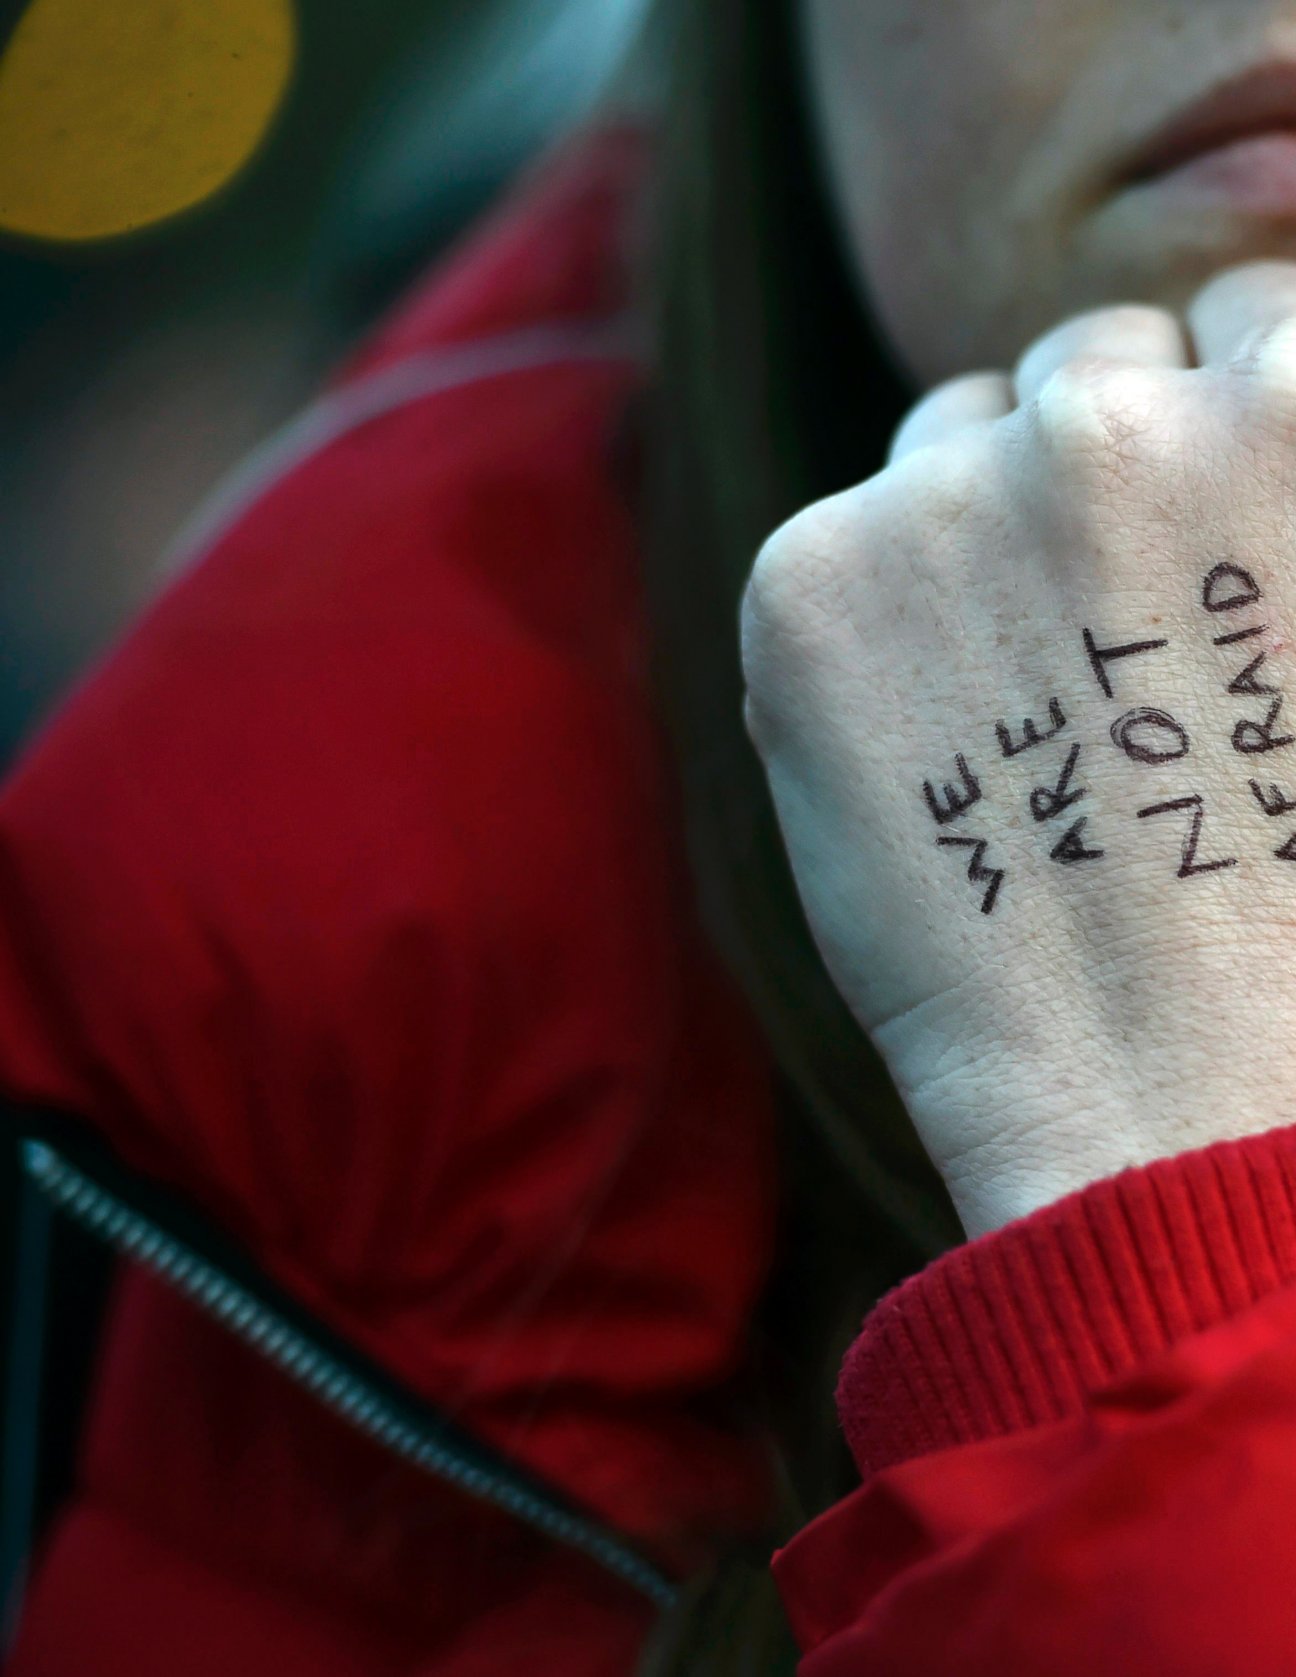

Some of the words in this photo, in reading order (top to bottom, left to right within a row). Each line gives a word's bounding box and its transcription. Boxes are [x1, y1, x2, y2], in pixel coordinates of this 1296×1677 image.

[923, 752, 1005, 915] WE
[995, 697, 1104, 866] ARE
[1082, 627, 1238, 879] NOT
